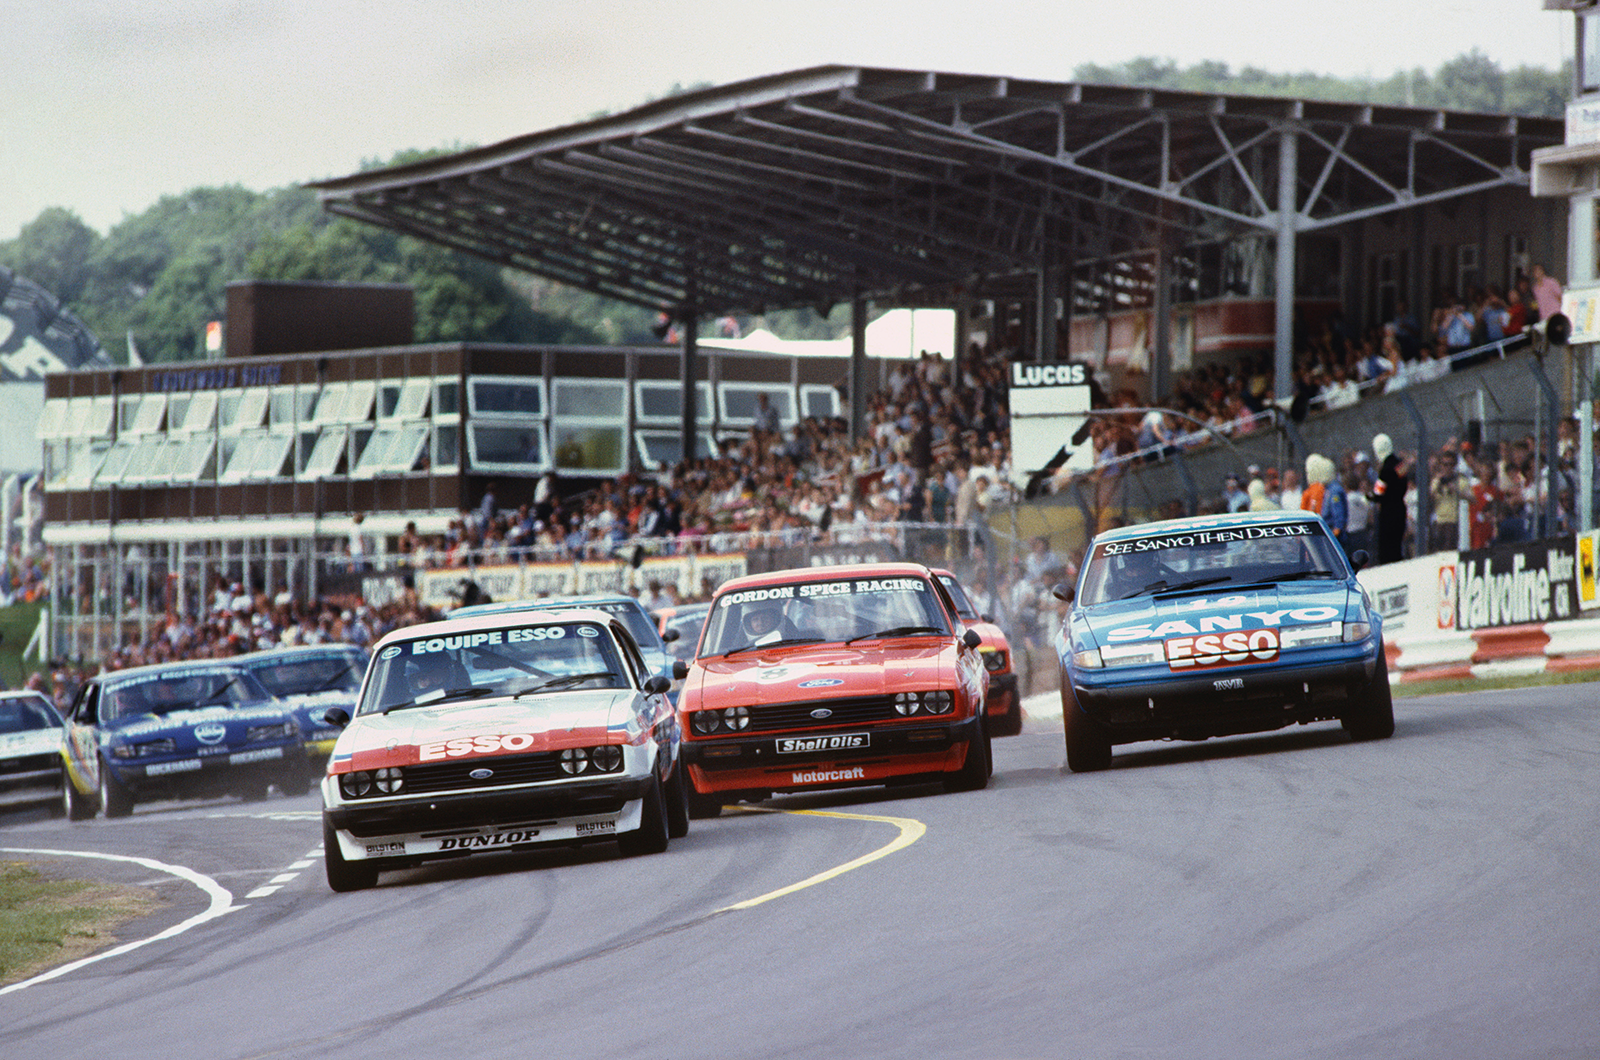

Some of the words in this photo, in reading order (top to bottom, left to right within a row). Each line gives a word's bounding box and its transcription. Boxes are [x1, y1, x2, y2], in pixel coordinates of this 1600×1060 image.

[1013, 362, 1085, 386] Lucas
[1103, 543, 1133, 557] SEE
[1193, 528, 1244, 545] THEN
[1247, 524, 1313, 540] DECIDE
[720, 587, 795, 608] GORDON
[799, 581, 851, 597] SPICE
[856, 578, 925, 593] RACING
[1458, 553, 1550, 629] Valvoline
[1107, 606, 1340, 641] SANYO
[412, 631, 503, 655] EQUIPE
[508, 626, 566, 643] ESSO
[1168, 629, 1278, 668] ESSO
[805, 679, 836, 687] Ford
[419, 733, 535, 761] ESSO
[783, 738, 828, 752] Shell
[829, 736, 863, 748] Oils
[792, 767, 864, 783] Motorcraft
[576, 819, 616, 831] BILSTEIN
[439, 829, 540, 850] DUNLOP
